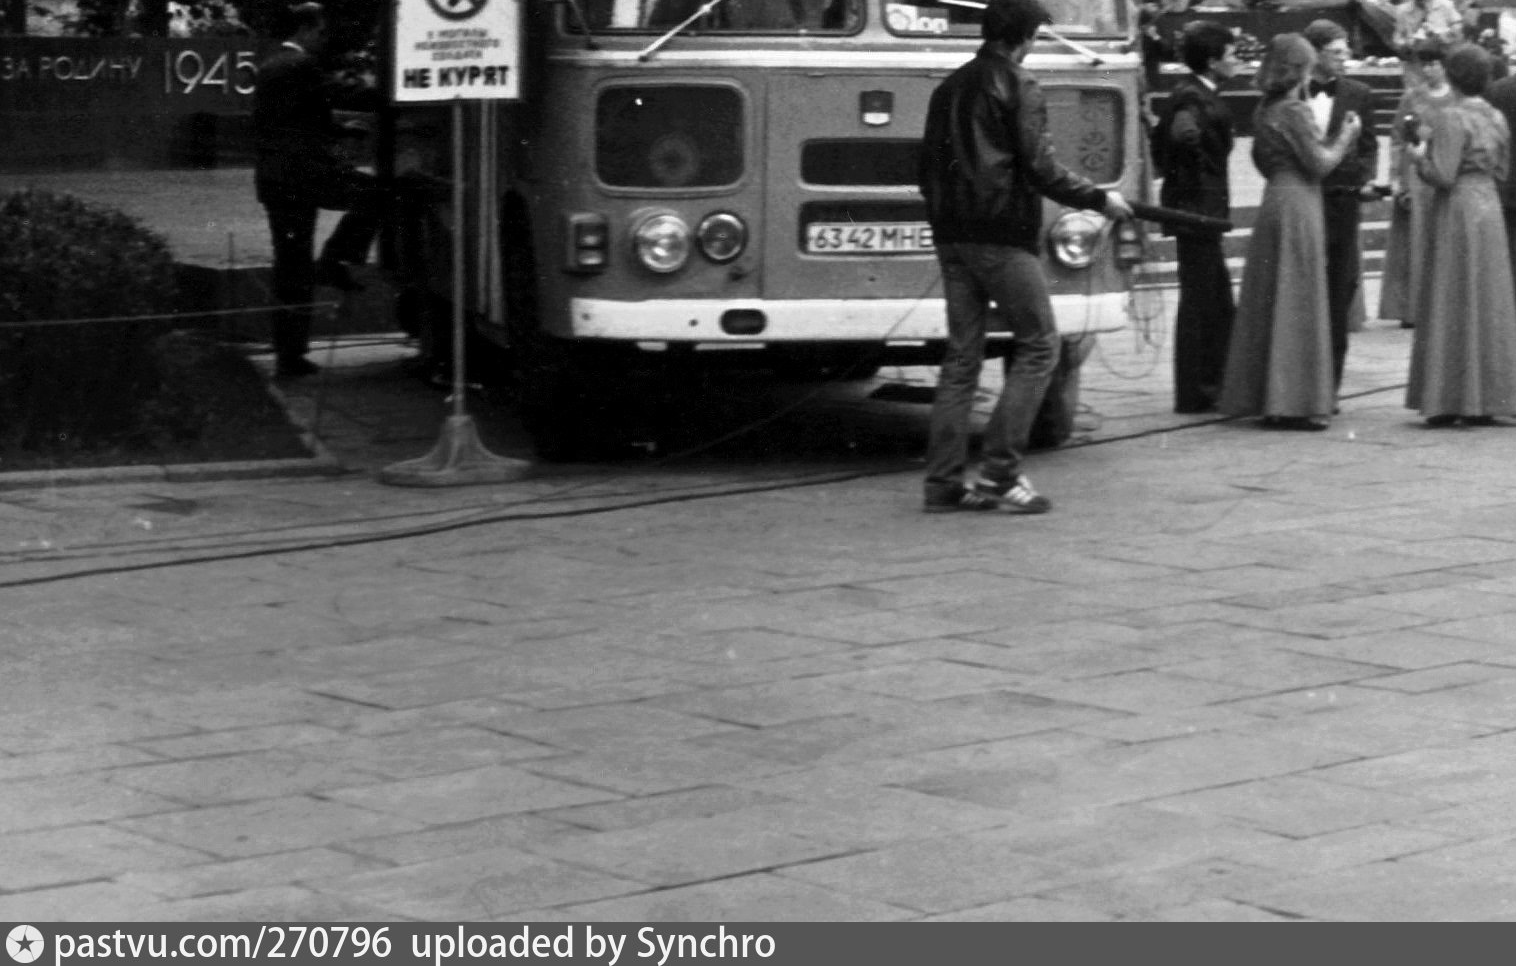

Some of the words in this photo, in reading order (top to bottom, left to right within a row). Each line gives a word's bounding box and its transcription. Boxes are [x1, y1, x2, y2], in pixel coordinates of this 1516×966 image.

[164, 49, 258, 94] 1945
[403, 68, 431, 89] НЕ
[438, 65, 509, 87] КУРЯТ
